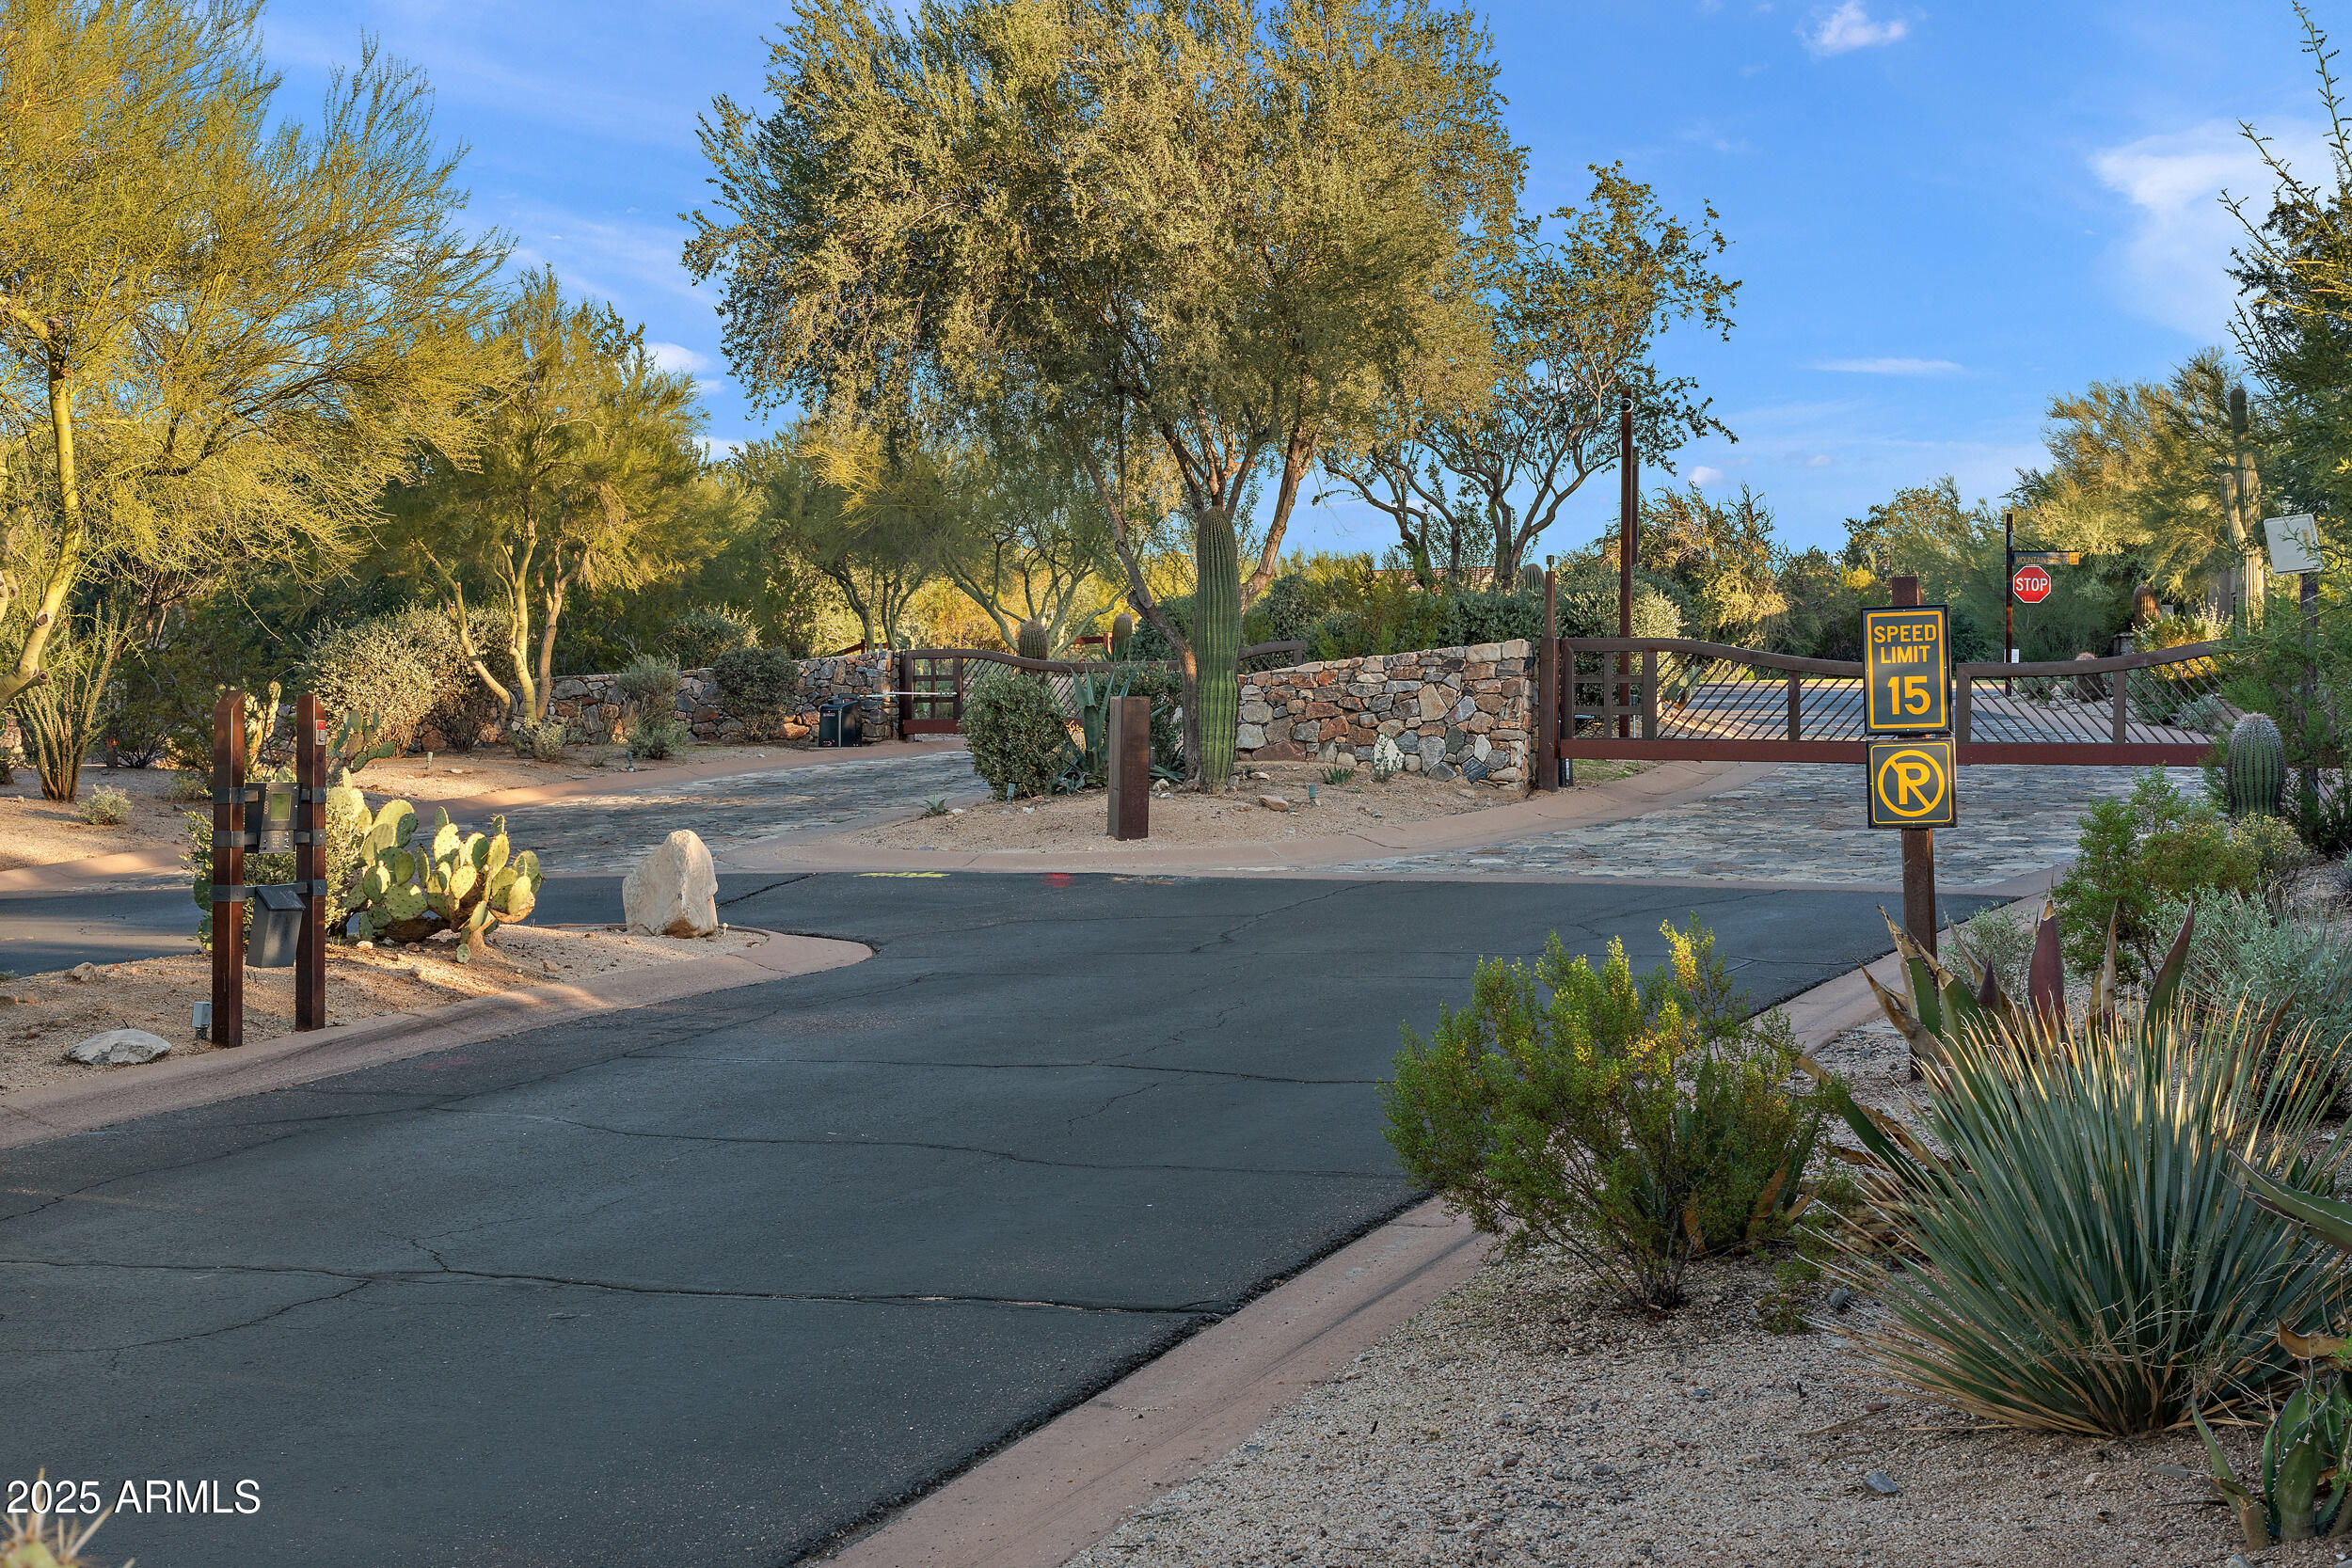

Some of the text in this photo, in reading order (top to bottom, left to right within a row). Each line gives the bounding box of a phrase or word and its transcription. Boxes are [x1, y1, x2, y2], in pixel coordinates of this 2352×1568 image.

[2015, 556, 2046, 564] MOUNTAIN
[2015, 577, 2048, 592] STOP
[1873, 624, 1937, 643] SPEED
[1880, 645, 1931, 664] LIMIT
[1887, 675, 1931, 716] 15
